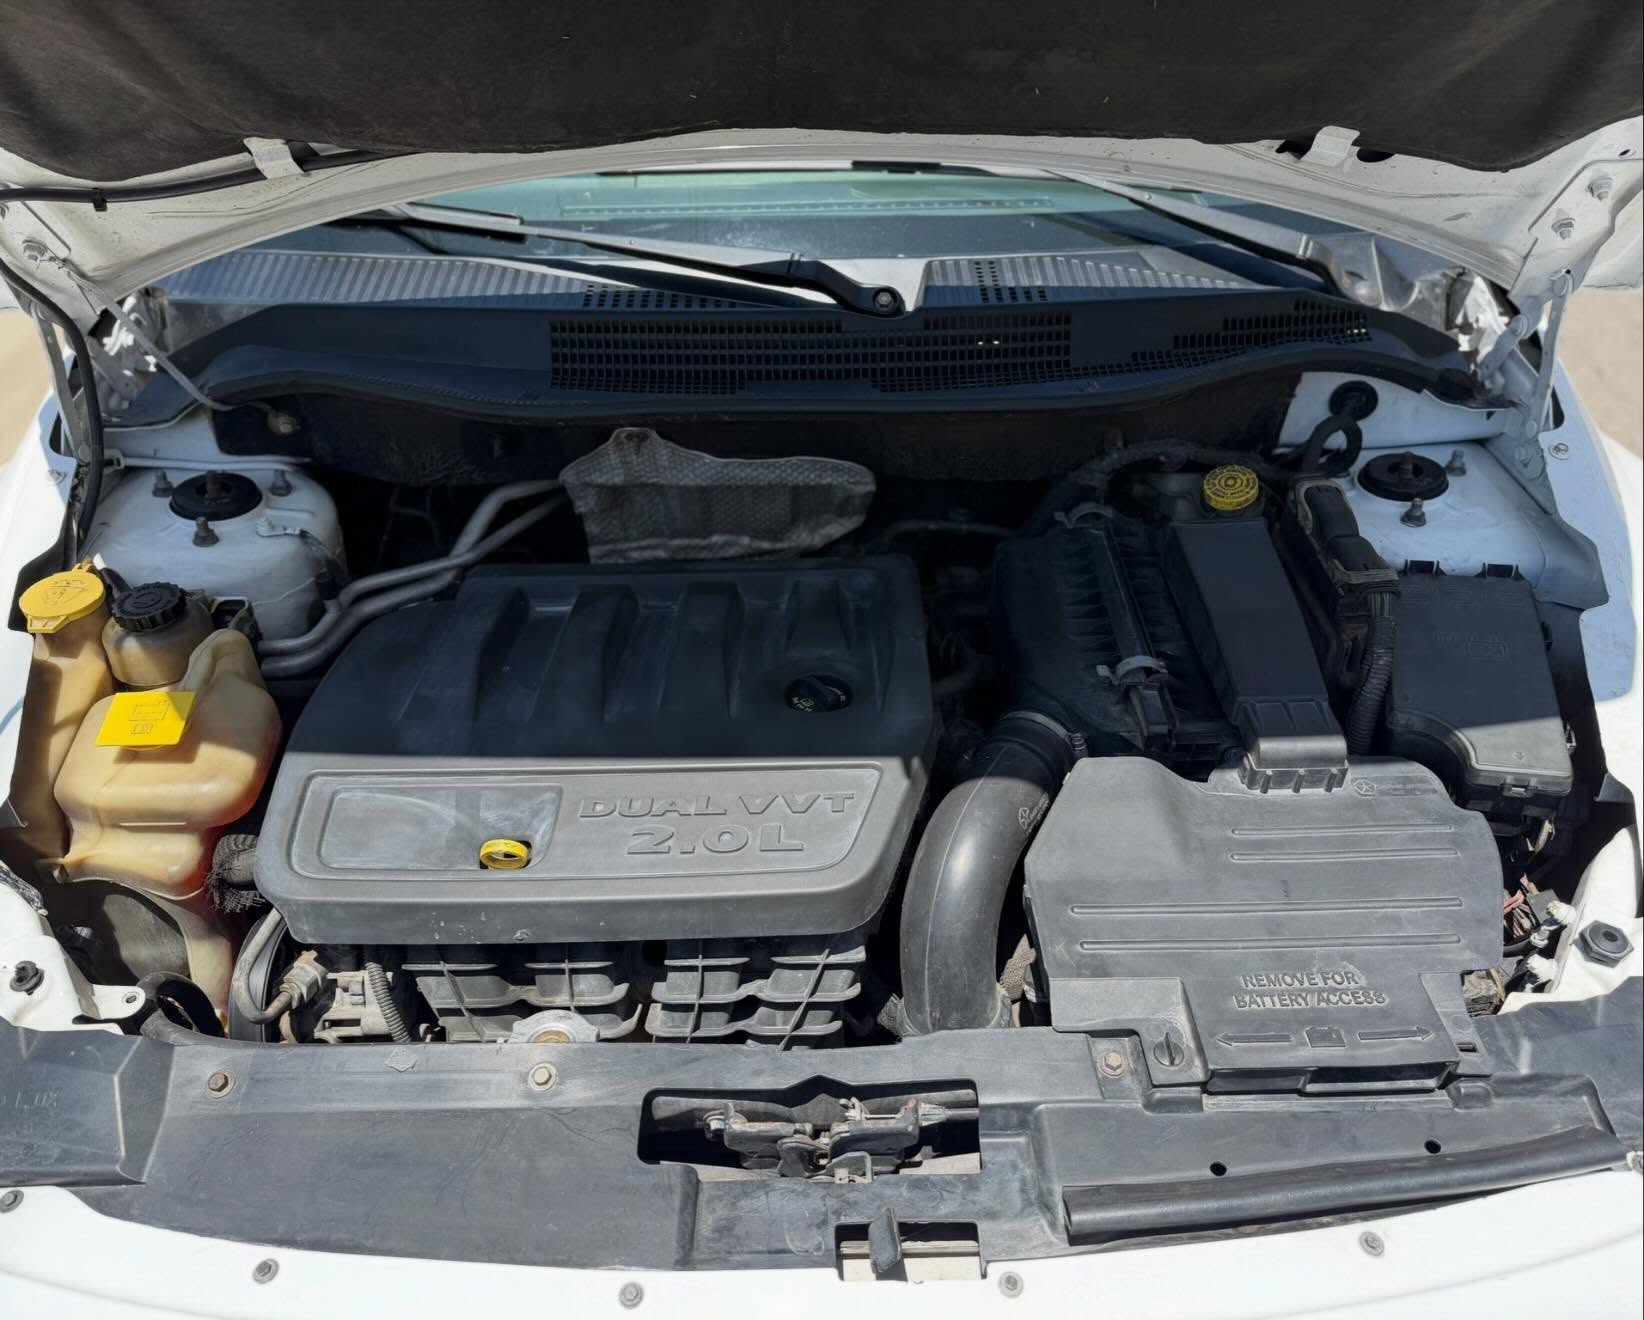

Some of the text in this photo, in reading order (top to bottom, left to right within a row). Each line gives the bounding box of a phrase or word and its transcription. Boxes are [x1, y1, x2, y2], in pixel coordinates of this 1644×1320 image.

[578, 793, 855, 818] DUAL VVT
[626, 823, 805, 855] 2.0L
[1241, 970, 1360, 989] REMOVE FOR
[1233, 990, 1387, 1009] BATTERY ACCESS
